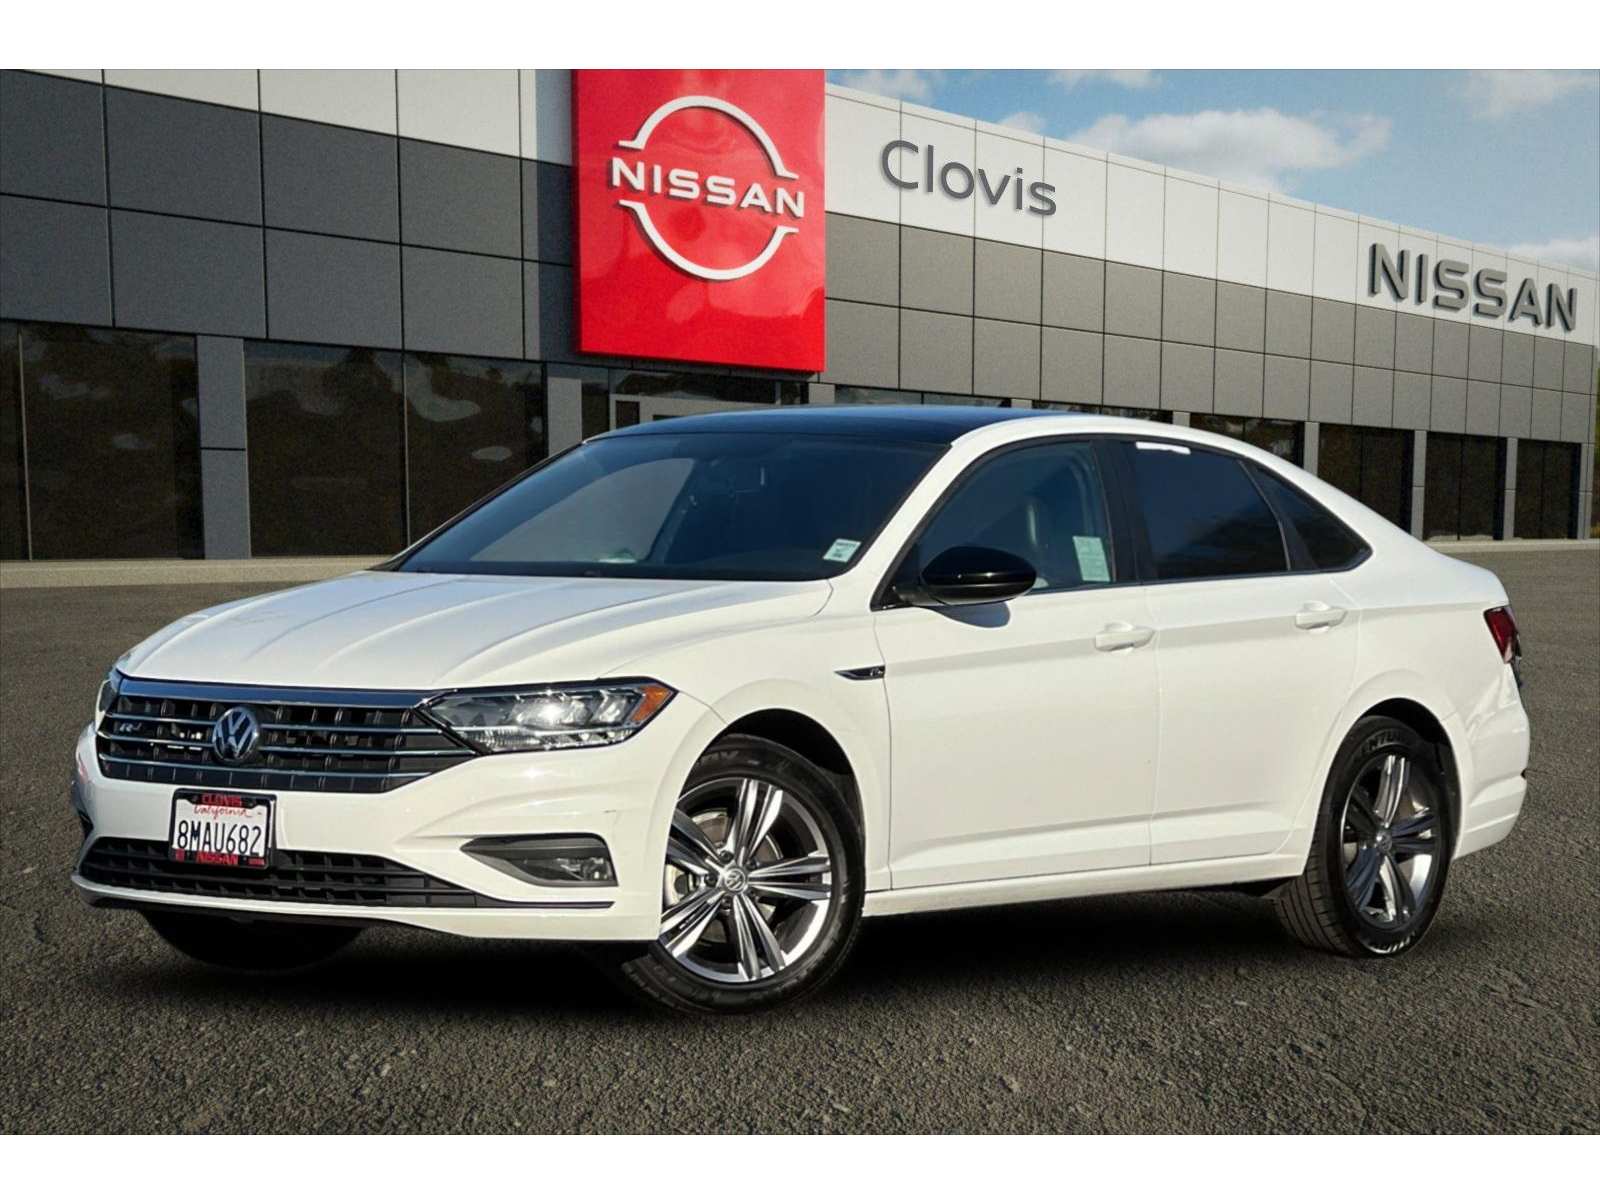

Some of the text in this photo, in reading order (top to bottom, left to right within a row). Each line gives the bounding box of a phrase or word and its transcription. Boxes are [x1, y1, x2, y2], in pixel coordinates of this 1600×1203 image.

[610, 156, 805, 218] NISSAN
[881, 139, 1057, 216] Clovis
[1368, 242, 1578, 332] NISSAN
[177, 819, 262, 857] 8MAU682
